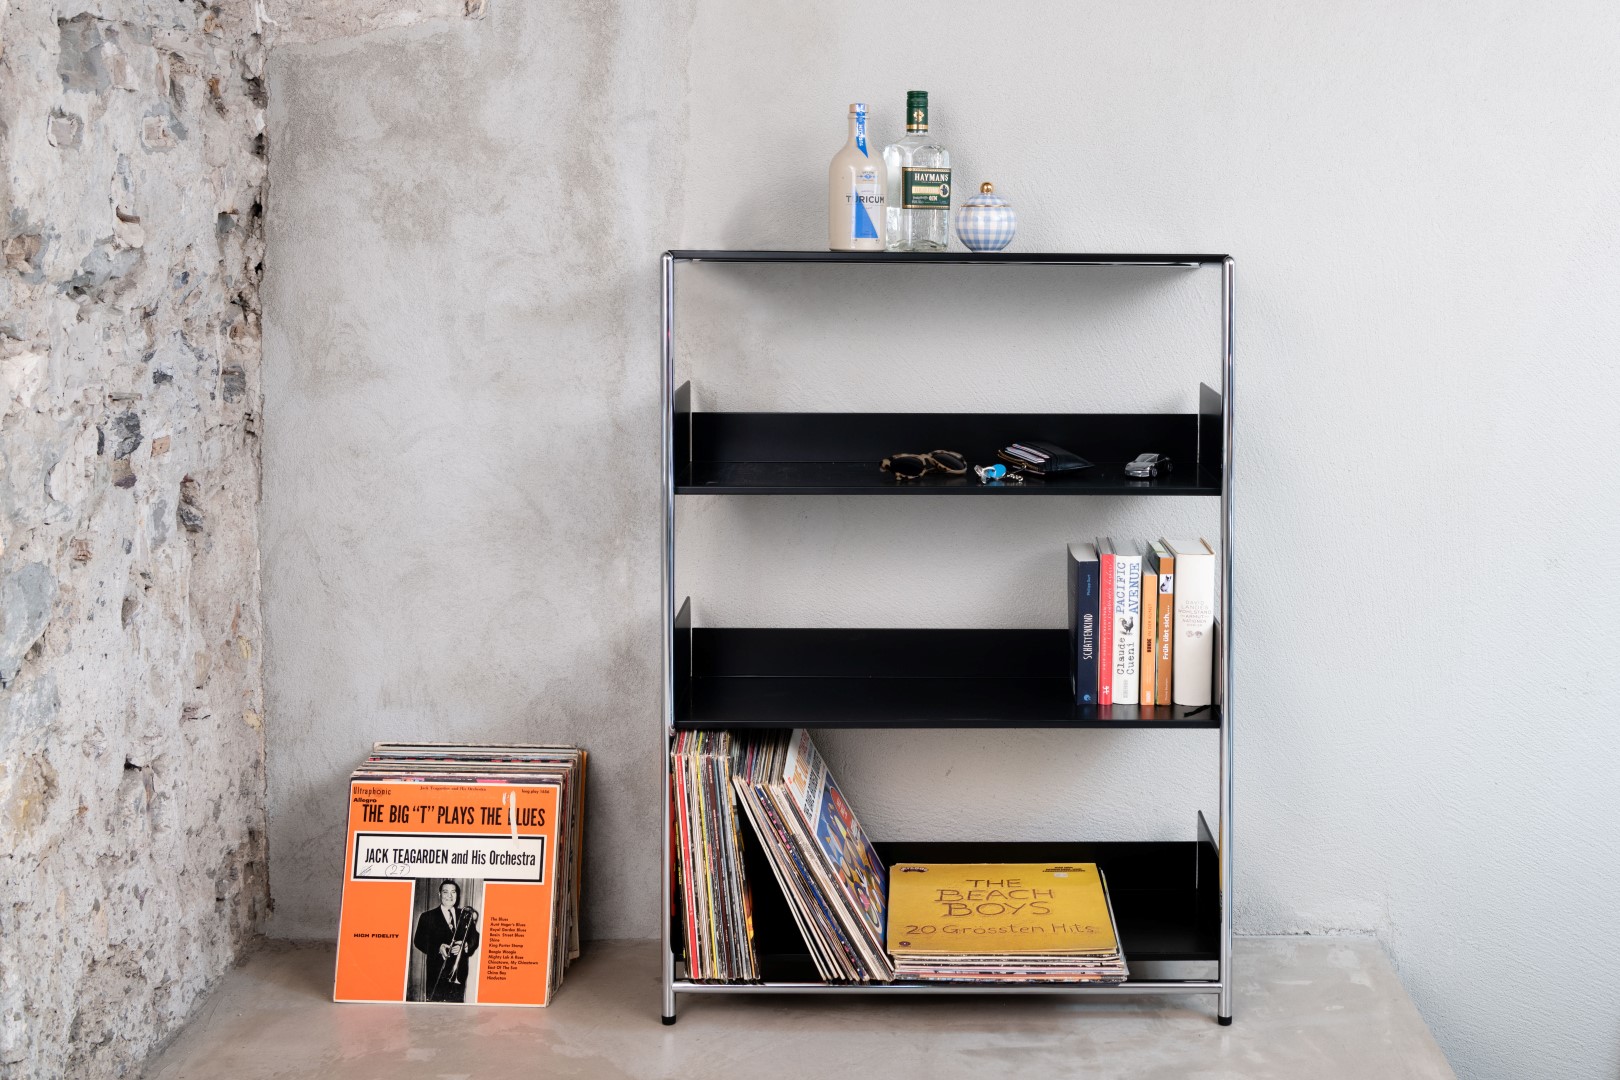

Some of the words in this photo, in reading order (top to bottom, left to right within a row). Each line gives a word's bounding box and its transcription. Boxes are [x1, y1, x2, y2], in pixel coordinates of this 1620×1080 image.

[1116, 562, 1126, 614] PACIFIC
[1129, 563, 1139, 614] AVENUE
[1083, 614, 1094, 660] SCHATTENKIND
[1117, 637, 1125, 674] Claude
[1126, 642, 1135, 675] Cueni
[354, 787, 392, 796] Ultraphonic
[362, 804, 384, 822] THE
[390, 805, 410, 823] BIG
[437, 806, 475, 825] PLAYS
[480, 807, 502, 825] THE
[365, 848, 388, 863] JACK
[393, 849, 448, 864] TEAGARDEN
[451, 850, 468, 864] and
[472, 850, 486, 865] His
[489, 850, 535, 866] Orchestra
[966, 879, 1022, 888] THE
[934, 889, 1054, 902] BEACH
[941, 901, 1052, 917] BOYS
[906, 925, 936, 935] 20
[943, 923, 1044, 934] Grössten
